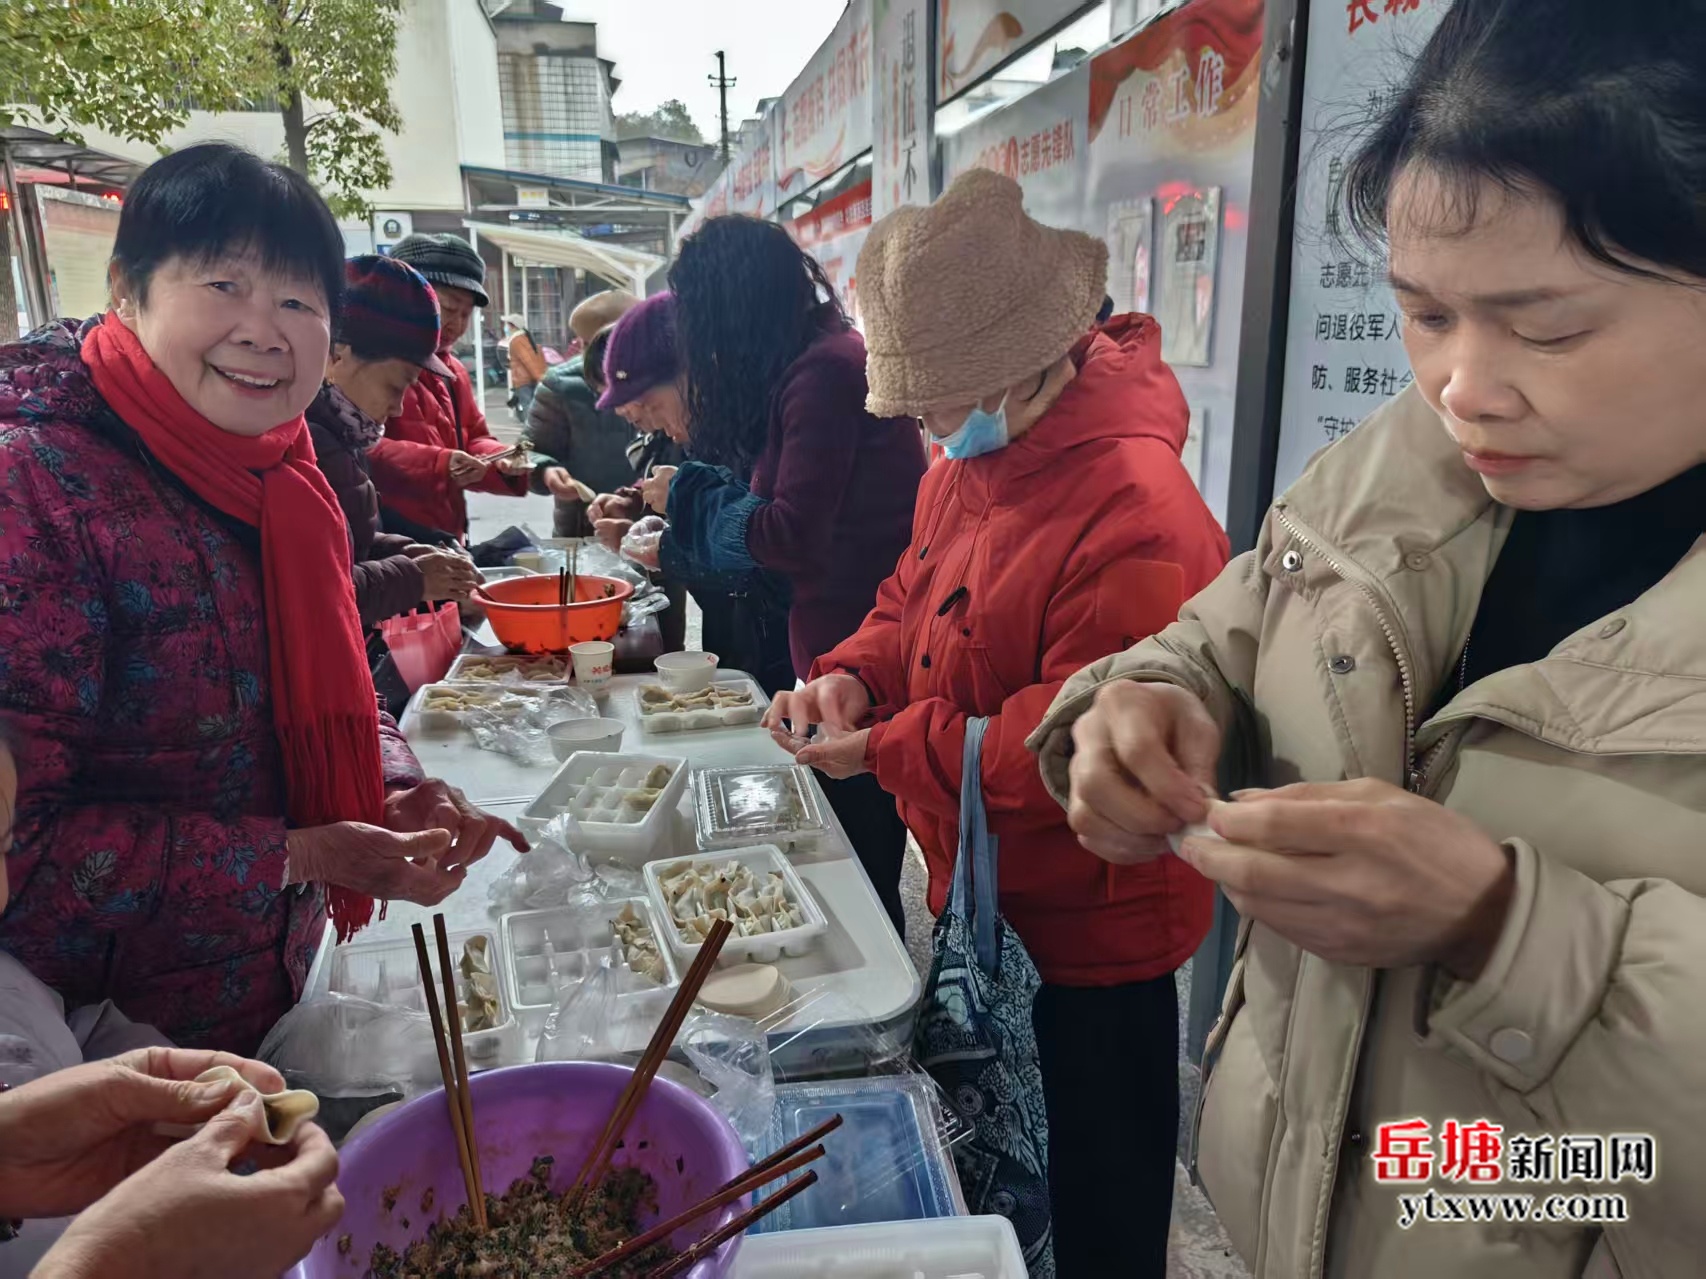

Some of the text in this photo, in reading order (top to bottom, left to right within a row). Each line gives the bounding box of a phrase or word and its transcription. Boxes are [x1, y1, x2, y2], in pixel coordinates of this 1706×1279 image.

[1320, 262, 1374, 288] 志愿先
[1315, 313, 1401, 341] 问退役军人
[1317, 416, 1361, 441] “守护
